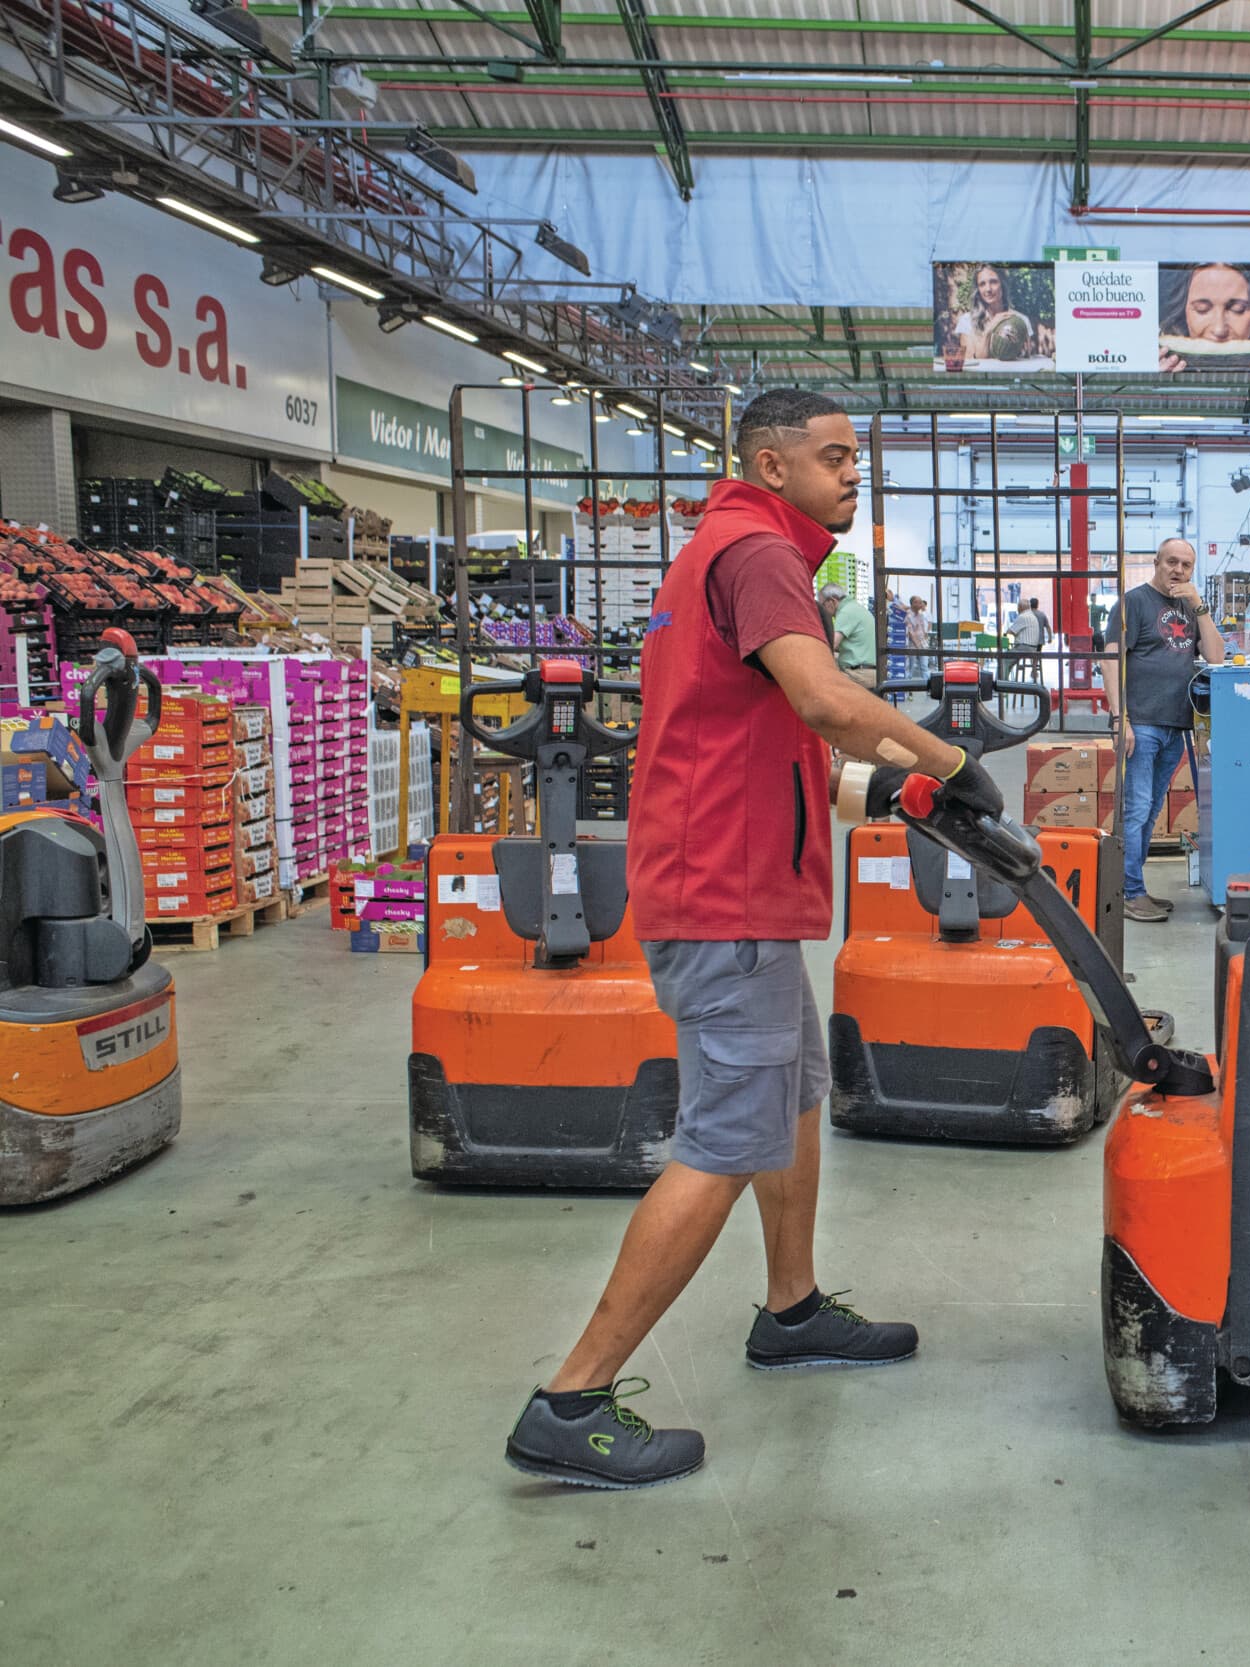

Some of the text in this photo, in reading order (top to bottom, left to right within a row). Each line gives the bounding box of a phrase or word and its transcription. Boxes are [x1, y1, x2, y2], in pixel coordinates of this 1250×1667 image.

[1068, 287, 1146, 302] con lo bueno.
[1081, 271, 1132, 287] Quédate
[0, 214, 247, 390] as s.a.
[285, 395, 318, 427] 6037
[416, 422, 421, 452] i
[95, 1015, 165, 1059] STILL
